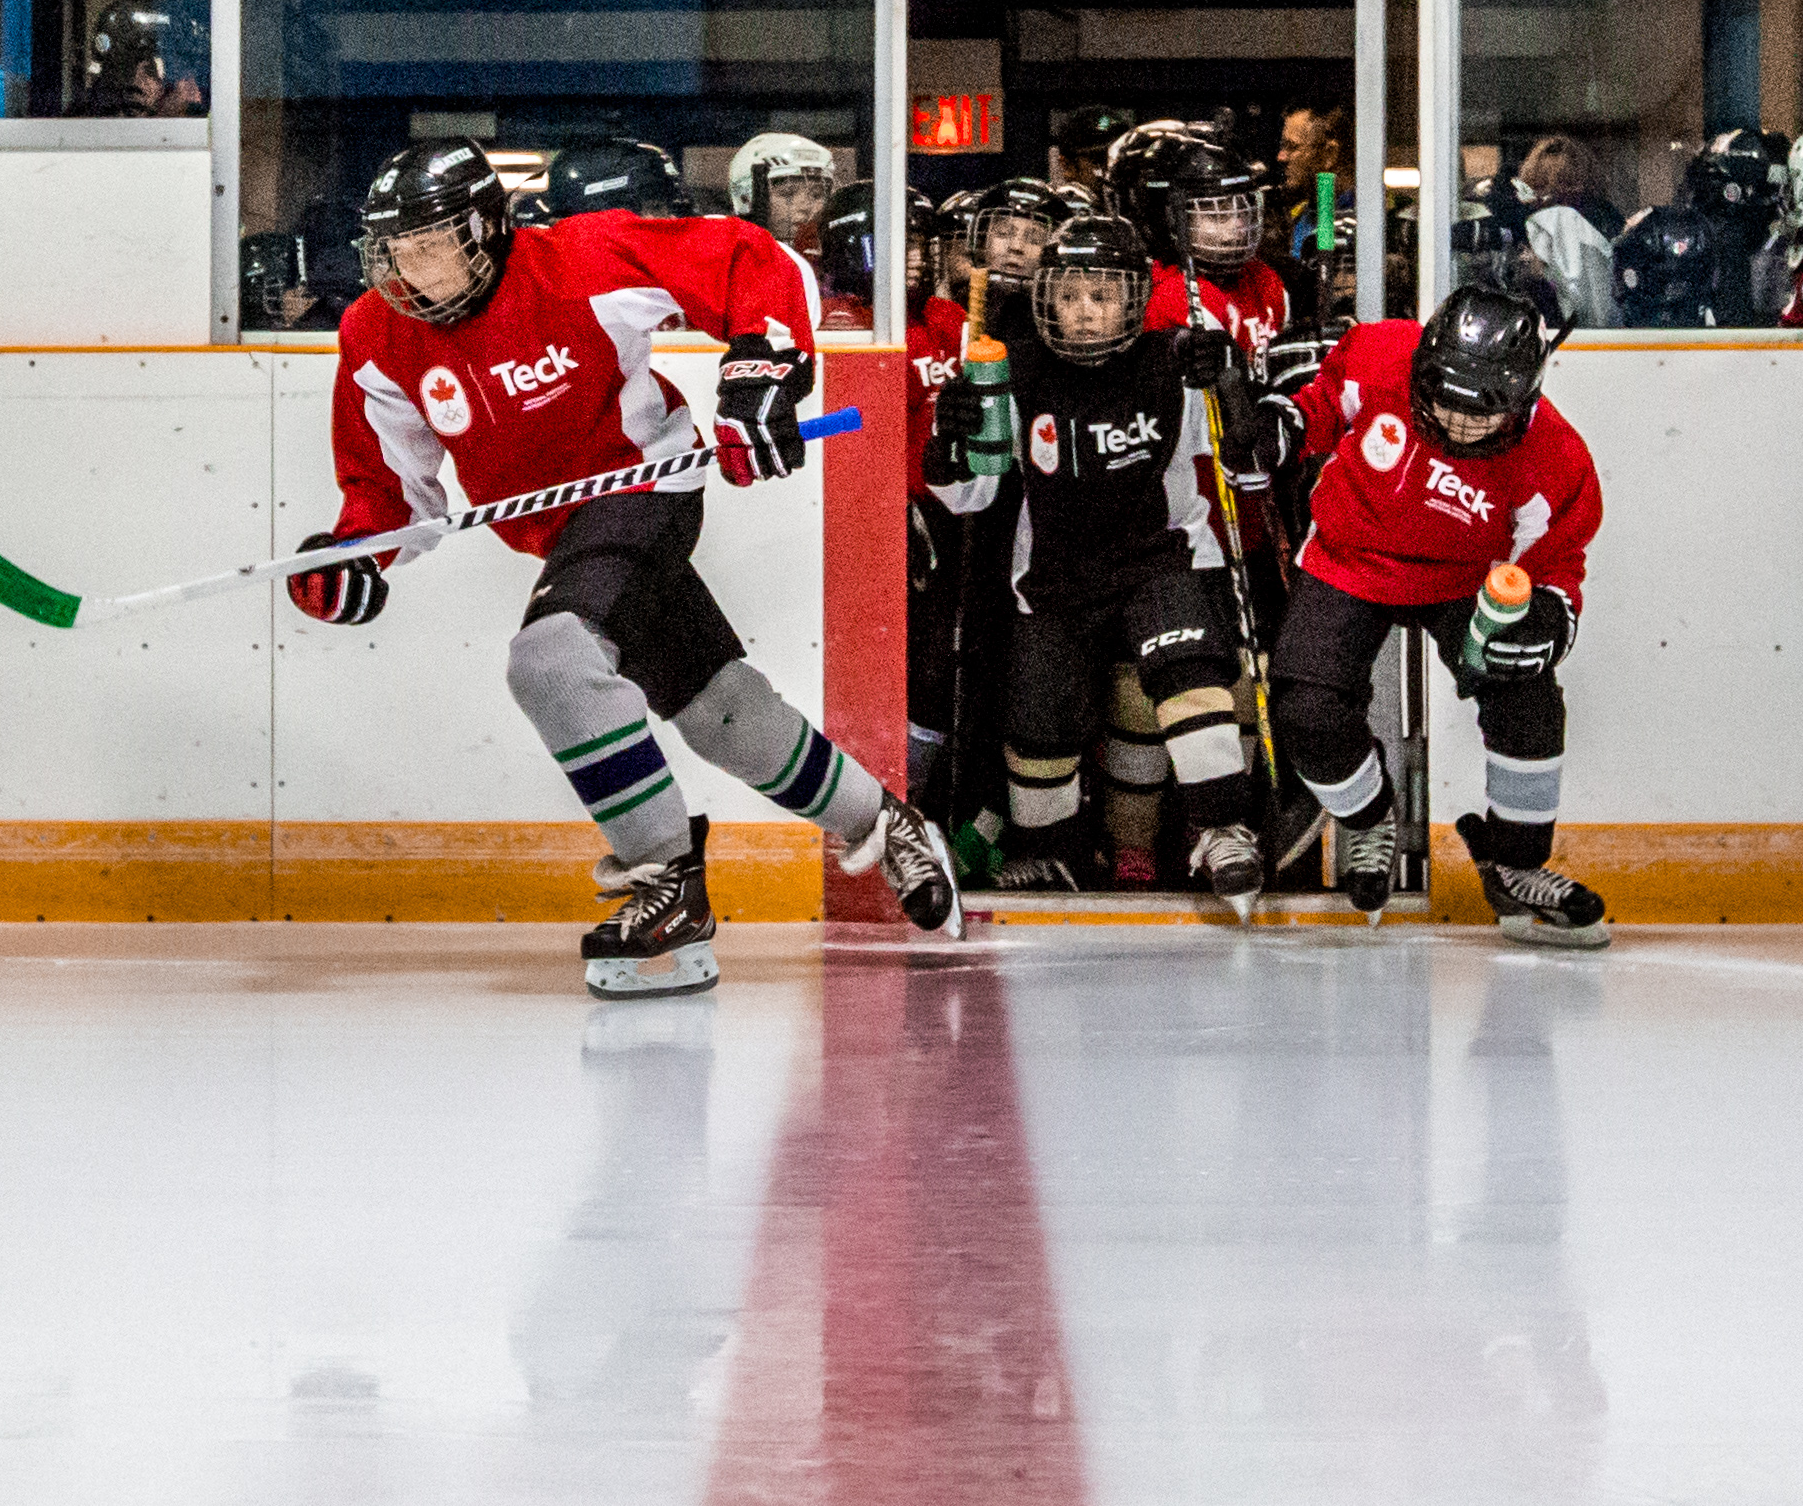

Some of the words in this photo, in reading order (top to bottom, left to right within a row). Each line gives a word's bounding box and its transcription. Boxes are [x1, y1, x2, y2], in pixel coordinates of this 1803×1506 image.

[912, 94, 993, 146] EXIT
[489, 344, 579, 397] Teck
[720, 359, 794, 381] CM
[1088, 412, 1162, 454] Teck
[1425, 457, 1495, 523] Teck
[1141, 628, 1205, 656] CCM
